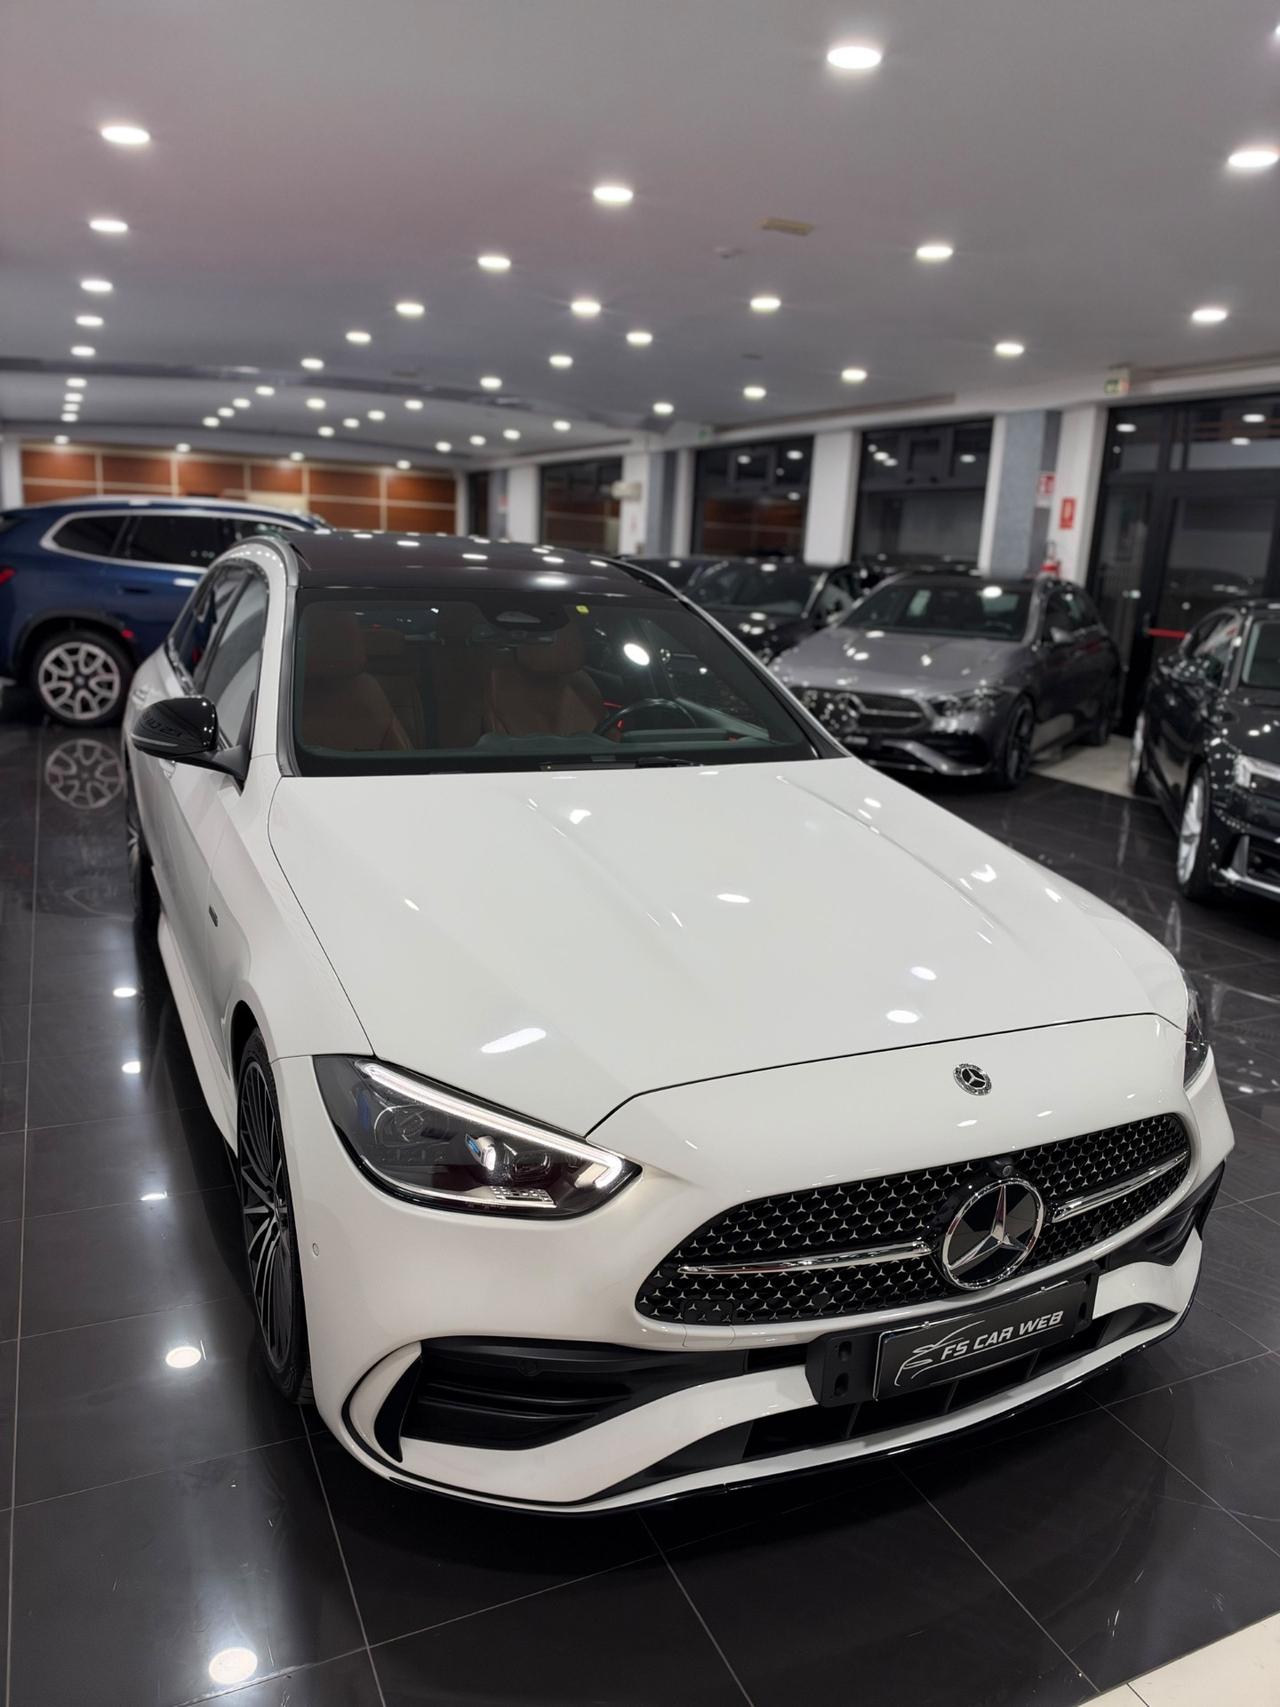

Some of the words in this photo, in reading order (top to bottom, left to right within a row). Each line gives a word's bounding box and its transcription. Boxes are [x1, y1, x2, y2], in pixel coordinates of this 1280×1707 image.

[941, 1340, 970, 1361] FS
[973, 1326, 1014, 1350] CAR
[1019, 1310, 1064, 1335] WEB
